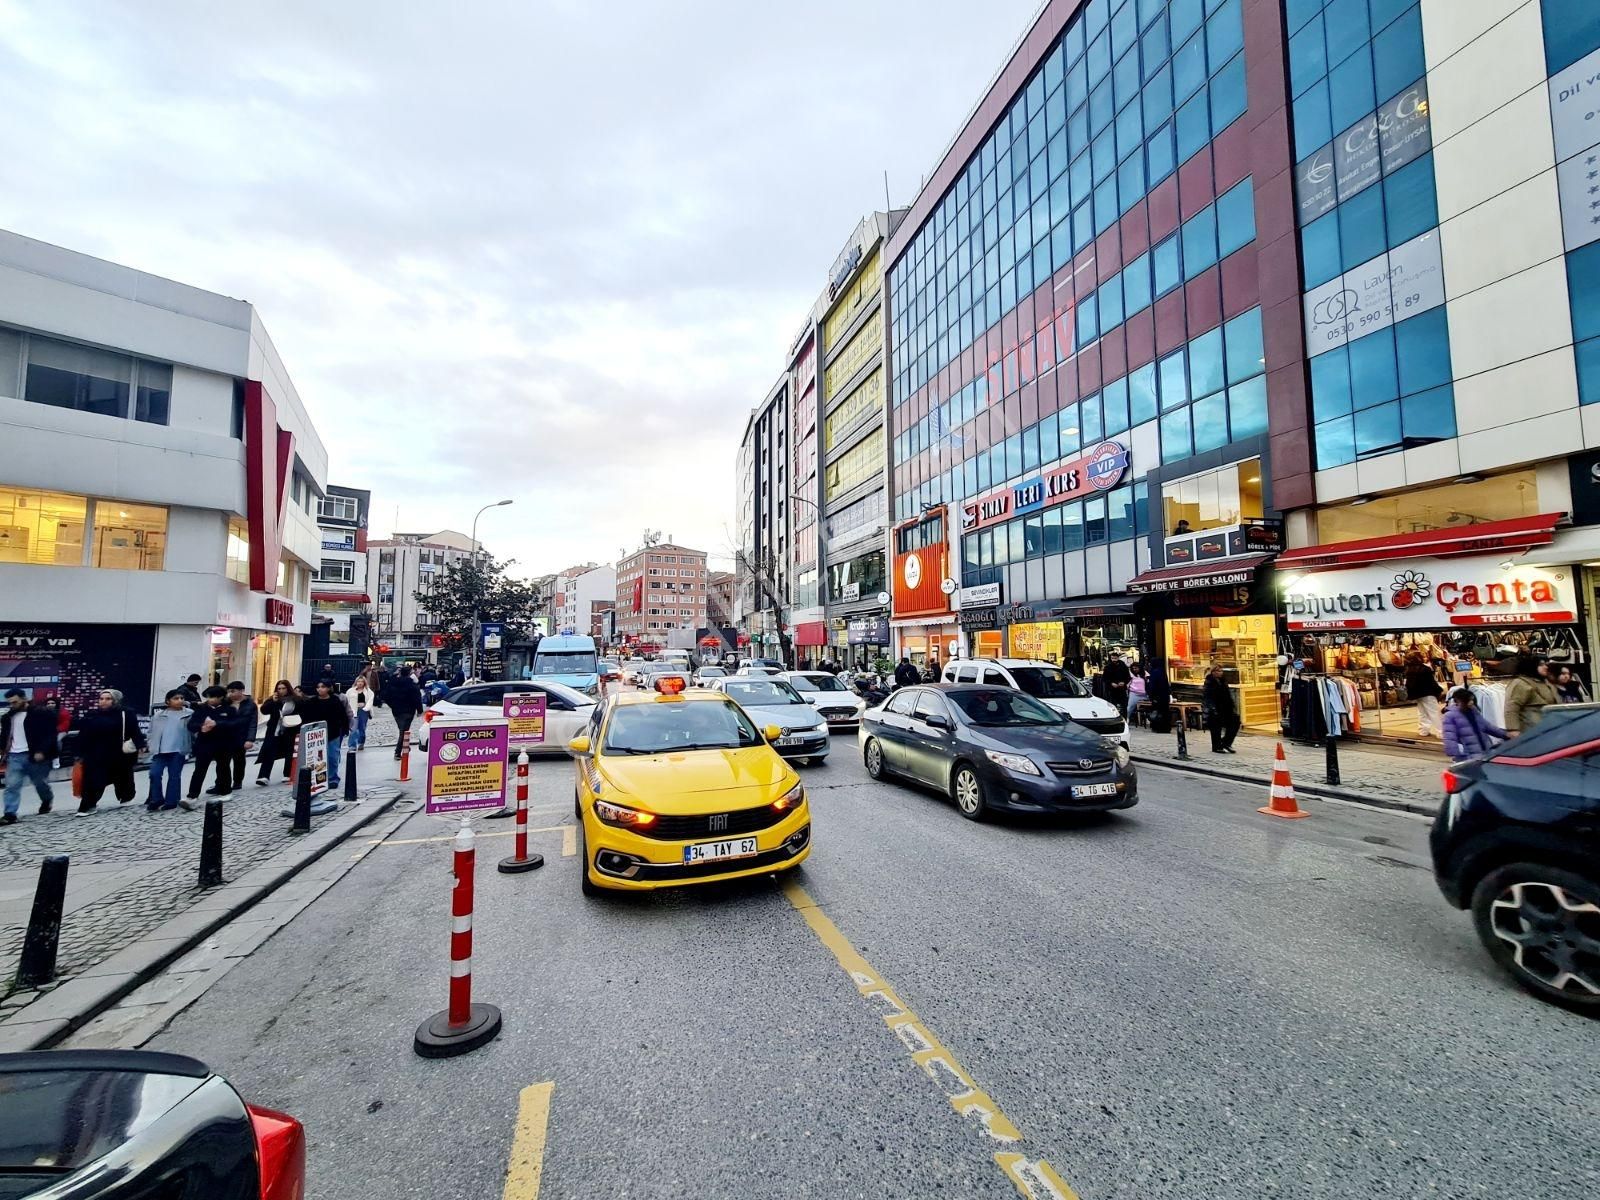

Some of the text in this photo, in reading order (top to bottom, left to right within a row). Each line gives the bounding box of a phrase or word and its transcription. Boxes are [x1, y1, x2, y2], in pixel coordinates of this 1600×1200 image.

[1559, 83, 1580, 102] Dil
[1327, 322, 1354, 340] 0530
[1360, 311, 1380, 327] 590
[1404, 293, 1420, 308] 89
[1097, 458, 1115, 473] VIP
[980, 469, 1077, 520] SINAV İLERİ KURS
[1151, 581, 1167, 591] PİDE
[1169, 581, 1178, 589] VE
[1183, 578, 1210, 588] BÖREK
[1212, 573, 1247, 584] SALONU
[1290, 578, 1554, 619] Bijuteri Çanta
[1302, 620, 1346, 628] KOZMETİK
[1481, 613, 1535, 623] TEKSTİL
[48, 638, 76, 646] var
[466, 746, 499, 756] GİYİM
[1075, 787, 1084, 796] 34
[1089, 786, 1098, 795] TG
[709, 814, 729, 831] FIAT
[692, 840, 754, 859] 34 TAY 62
